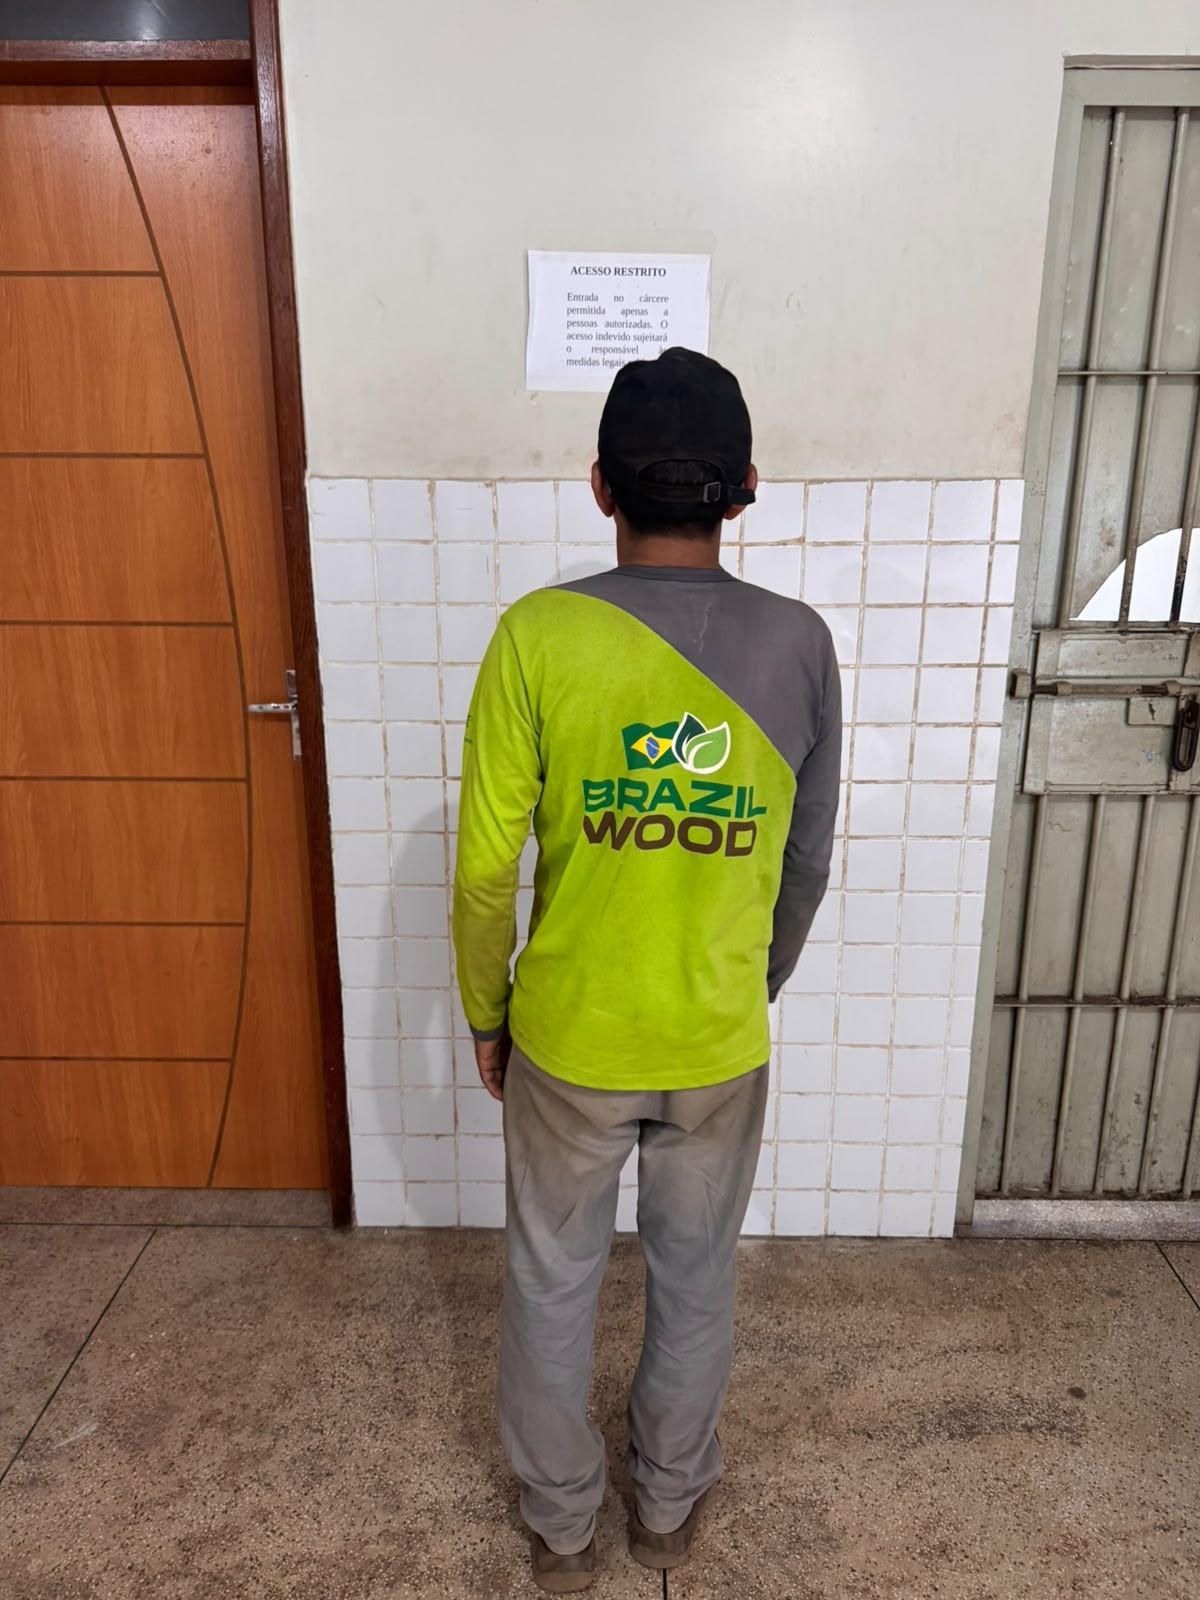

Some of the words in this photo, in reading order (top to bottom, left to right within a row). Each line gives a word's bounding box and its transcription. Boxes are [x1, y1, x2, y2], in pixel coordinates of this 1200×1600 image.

[570, 266, 611, 276] ACESSO
[614, 267, 666, 277] RESTRITO
[567, 293, 598, 302] Entrada
[639, 293, 669, 303] cárcere
[567, 306, 606, 316] permitida
[620, 308, 648, 317] apenas
[567, 320, 597, 329] pessoas
[605, 319, 653, 328] autorizadas.
[660, 320, 668, 329] O
[566, 333, 593, 341] acesso
[596, 332, 631, 341] indevido
[633, 333, 668, 344] sujeitará
[591, 345, 639, 356] responsável
[566, 357, 600, 366] medidas
[602, 358, 625, 369] legais
[582, 777, 768, 819] BRAZIL
[582, 811, 757, 857] WOOD
